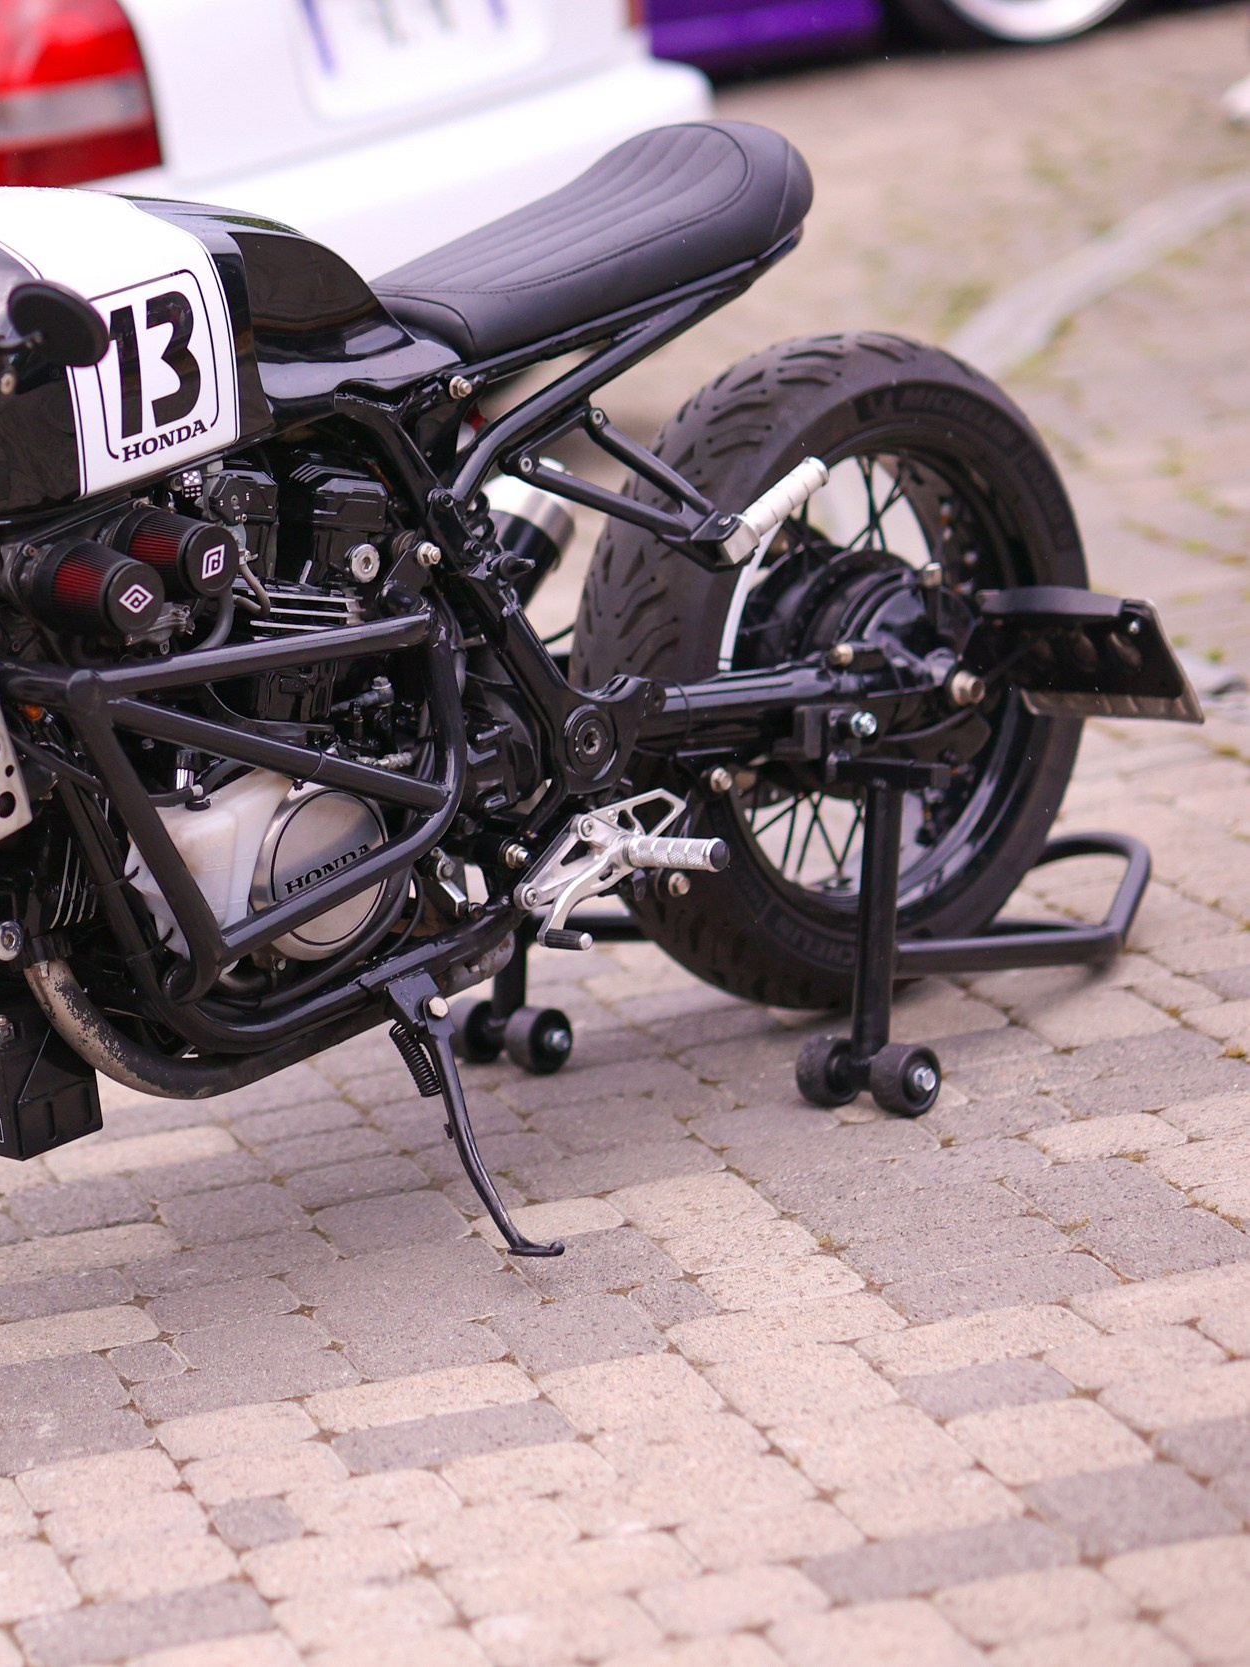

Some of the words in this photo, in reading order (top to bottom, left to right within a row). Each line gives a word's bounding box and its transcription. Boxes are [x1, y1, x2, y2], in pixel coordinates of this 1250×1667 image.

[109, 291, 200, 439] 13
[122, 419, 208, 462] HONDA
[285, 844, 371, 894] HONDA
